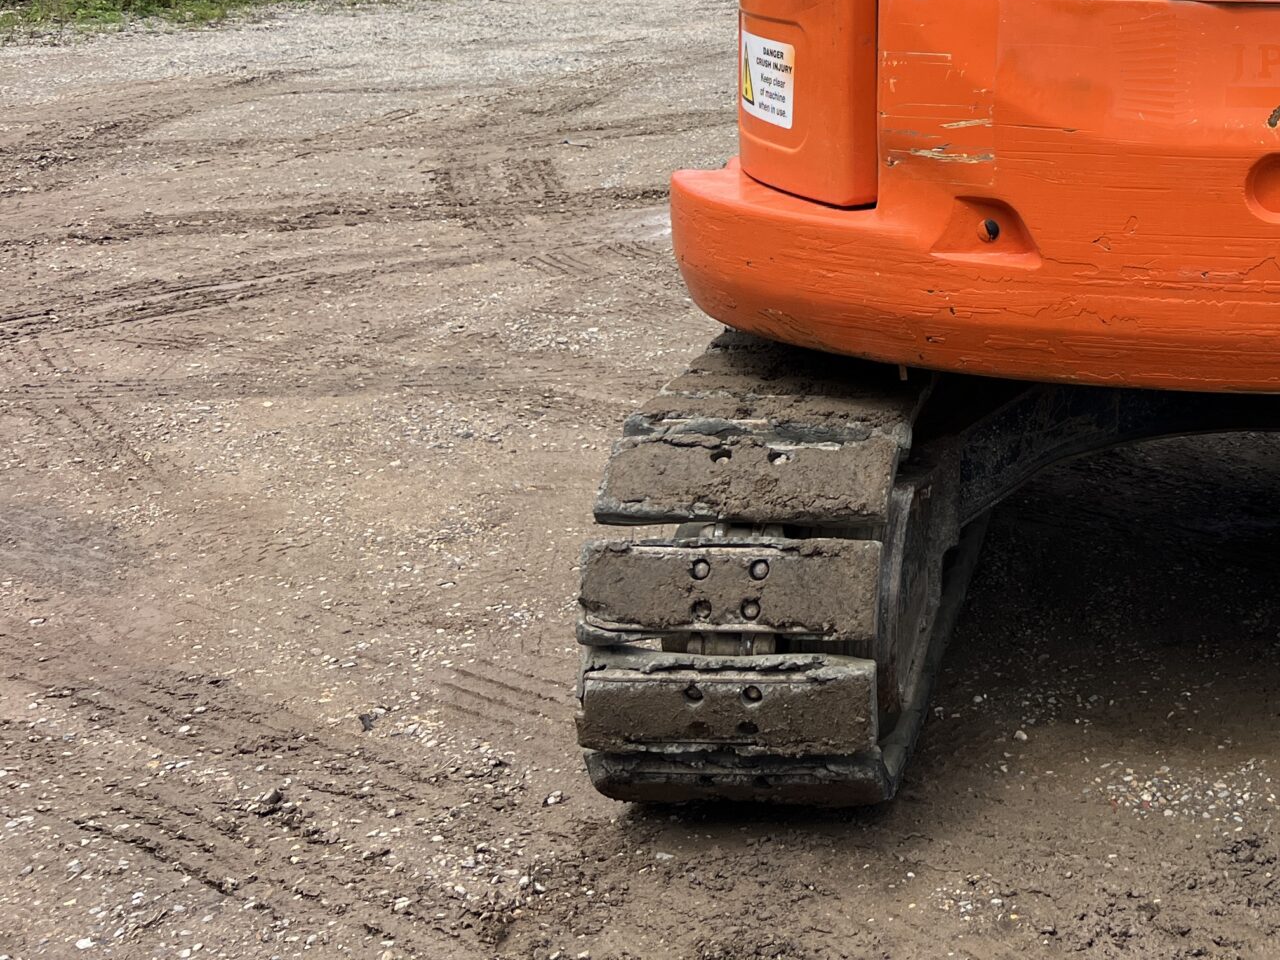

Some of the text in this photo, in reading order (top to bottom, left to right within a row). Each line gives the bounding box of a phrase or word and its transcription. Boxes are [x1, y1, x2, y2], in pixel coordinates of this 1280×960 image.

[763, 47, 784, 60] DANGER
[756, 57, 792, 74] CRUSH INJURY
[760, 73, 786, 89] Keep clear
[760, 87, 786, 103] of machine
[758, 101, 788, 118] when in use.
